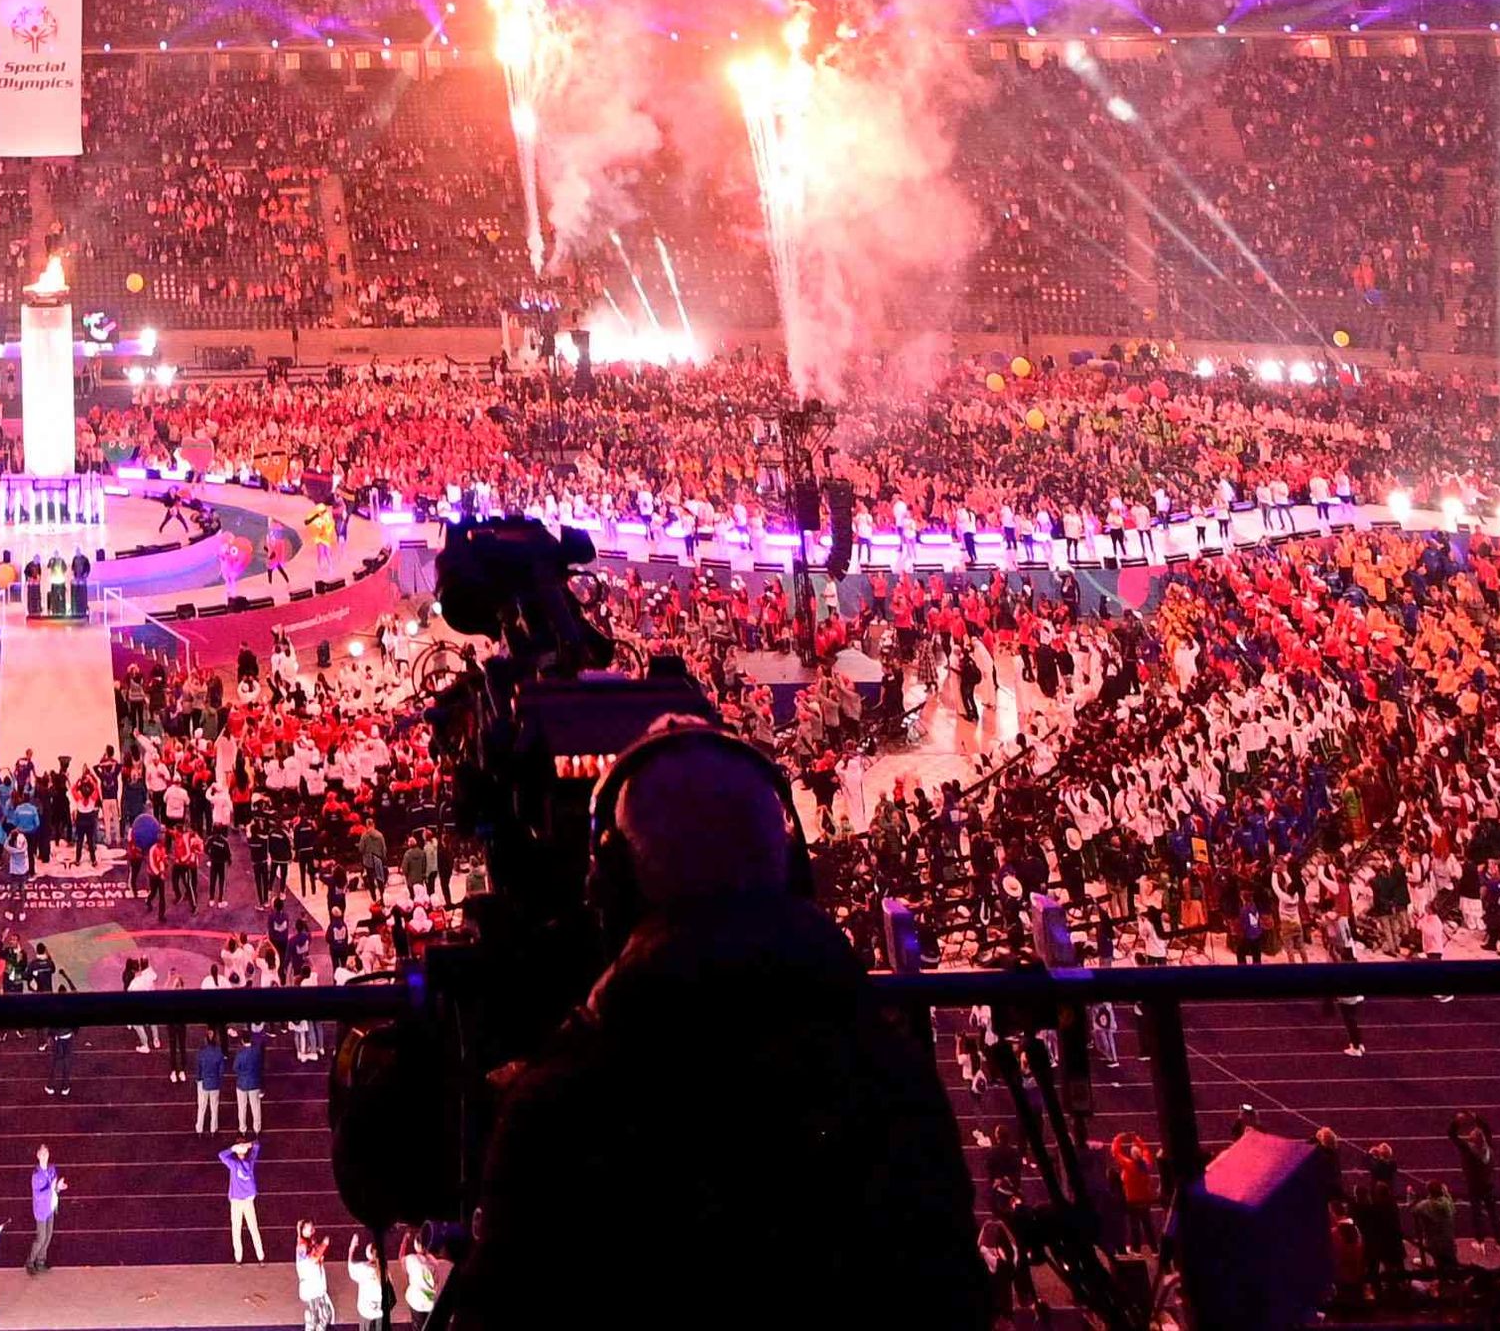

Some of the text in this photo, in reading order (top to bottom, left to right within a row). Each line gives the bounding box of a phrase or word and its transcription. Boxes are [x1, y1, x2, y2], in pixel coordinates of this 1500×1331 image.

[4, 61, 66, 75] Special
[60, 882, 127, 890] OLYMPIC
[71, 889, 149, 899] GAMES
